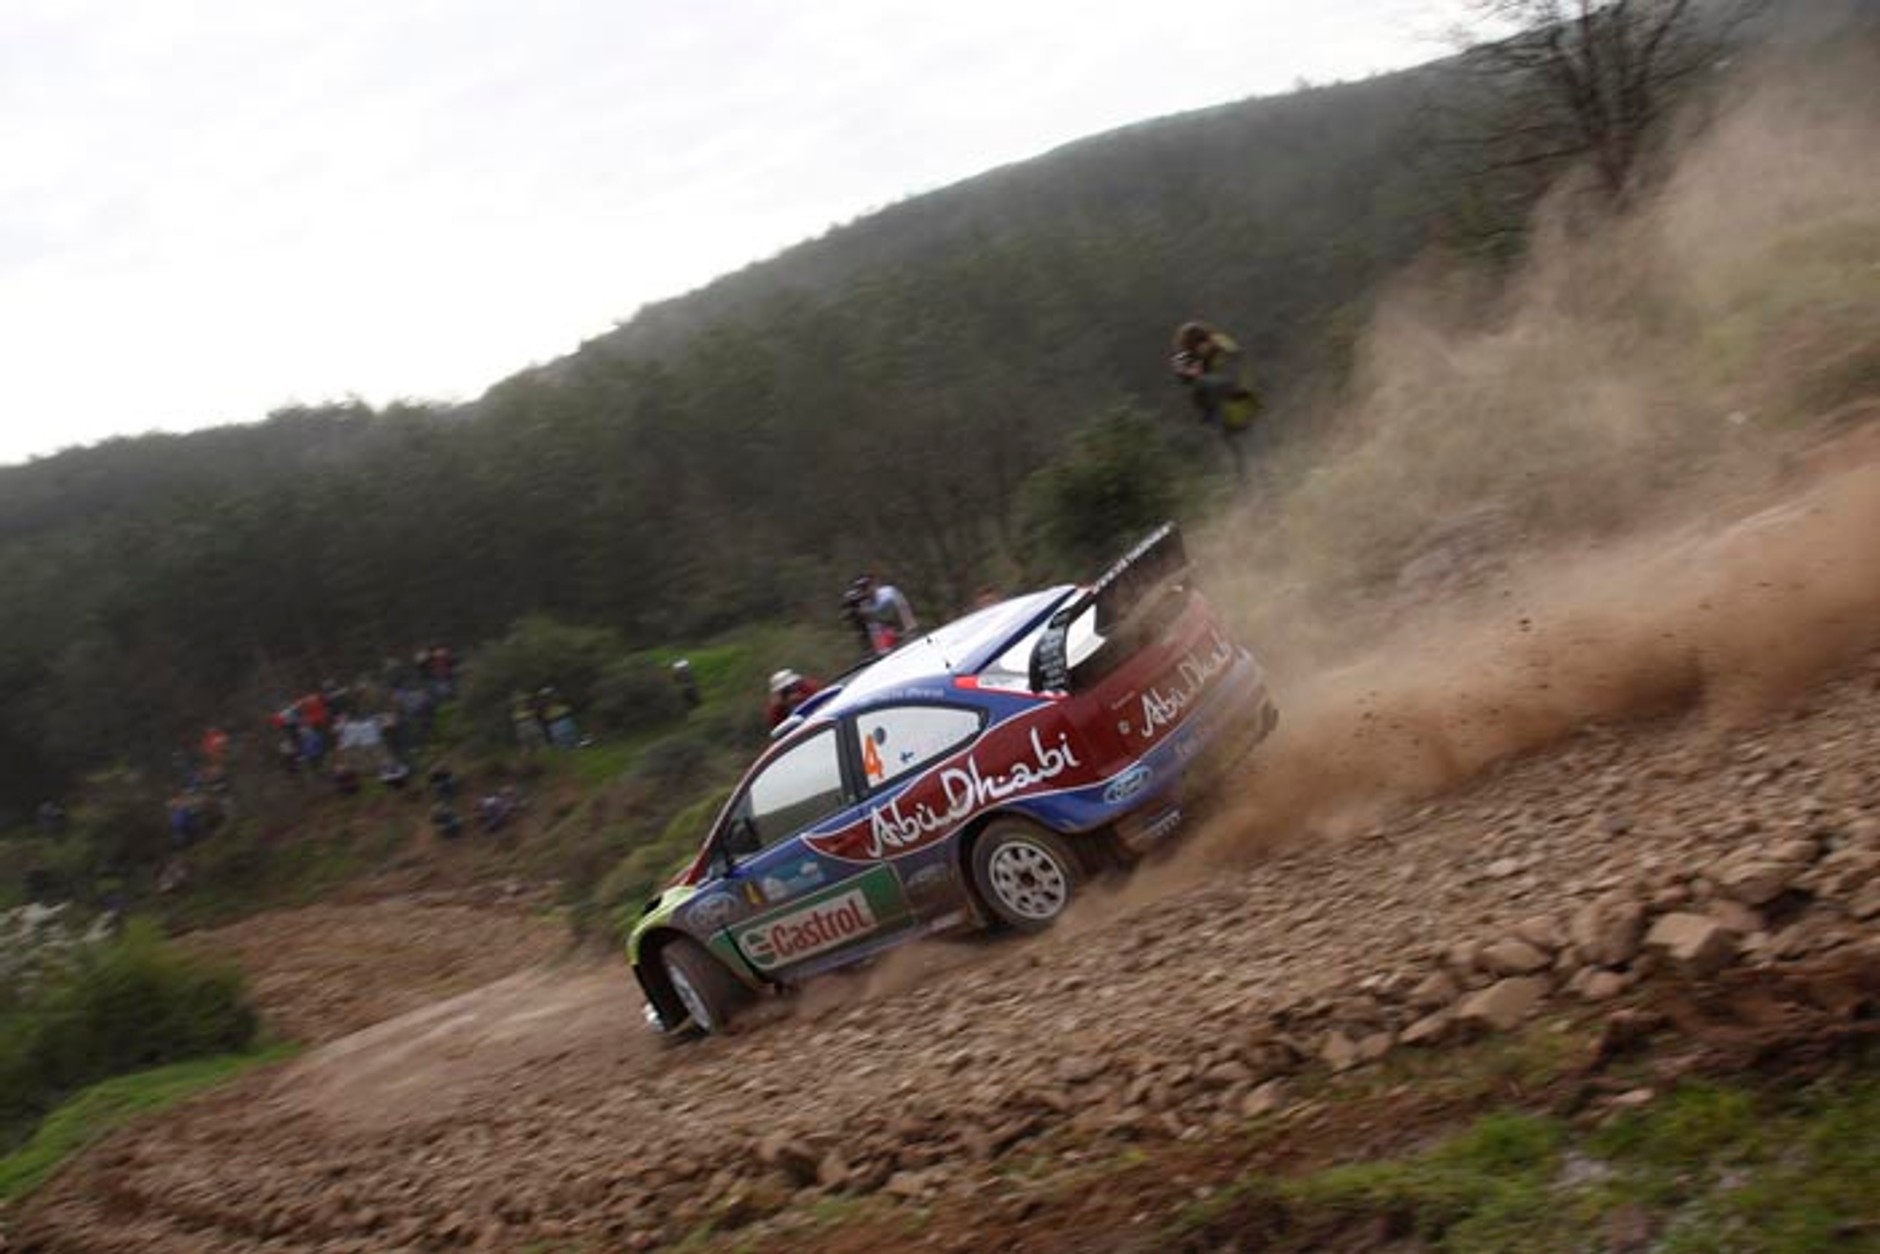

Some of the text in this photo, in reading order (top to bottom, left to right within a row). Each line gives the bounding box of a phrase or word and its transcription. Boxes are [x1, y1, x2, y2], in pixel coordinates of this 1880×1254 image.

[1141, 684, 1186, 738] Abu
[863, 734, 884, 779] 4
[866, 726, 1080, 858] Abu Dhabi
[769, 899, 869, 957] Castrol
